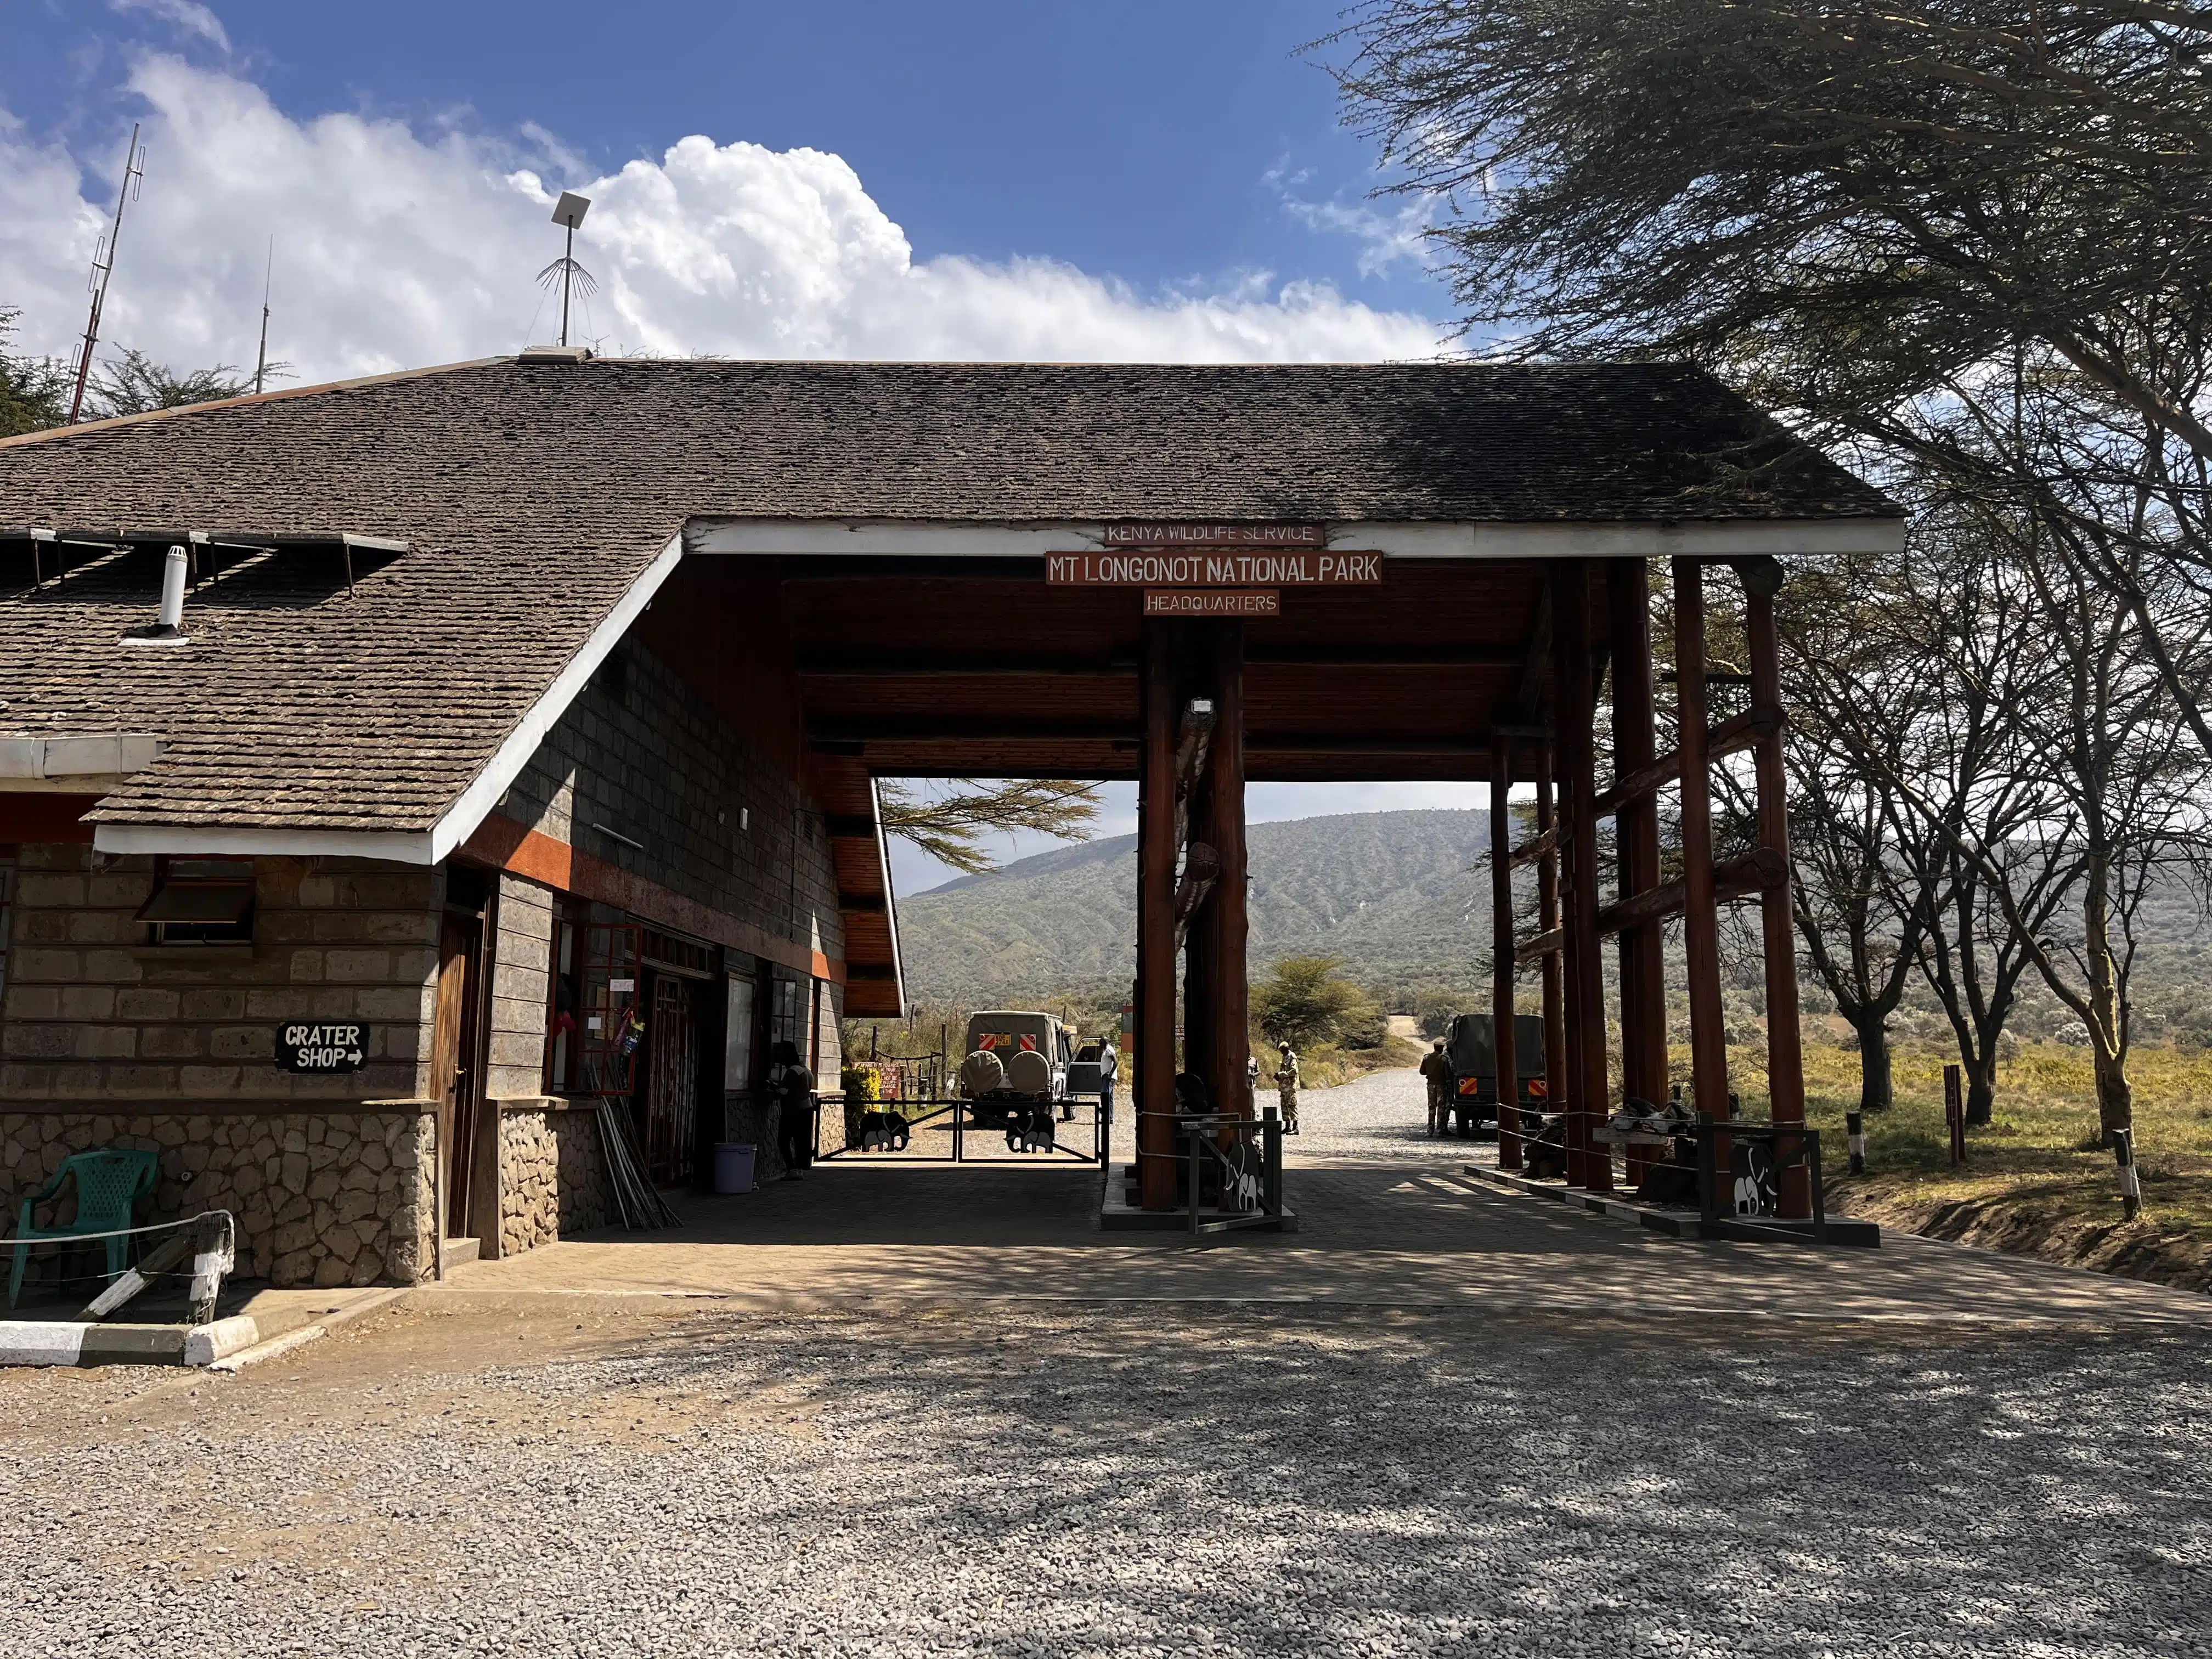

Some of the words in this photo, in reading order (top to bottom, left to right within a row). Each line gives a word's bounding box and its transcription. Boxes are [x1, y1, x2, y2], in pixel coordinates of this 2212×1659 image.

[1108, 526, 1164, 541] KENYA
[1169, 525, 1237, 541] WILDLIFE
[1242, 525, 1313, 540] SERVICE
[1049, 556, 1079, 582] MT
[1085, 556, 1202, 582] LONGONOT
[1207, 556, 1314, 582] NATIONAL
[1319, 555, 1379, 581] PARK
[1147, 595, 1277, 611] HEADQUARTERS
[285, 1025, 360, 1046] CRATER
[296, 1047, 346, 1067] SHOP
